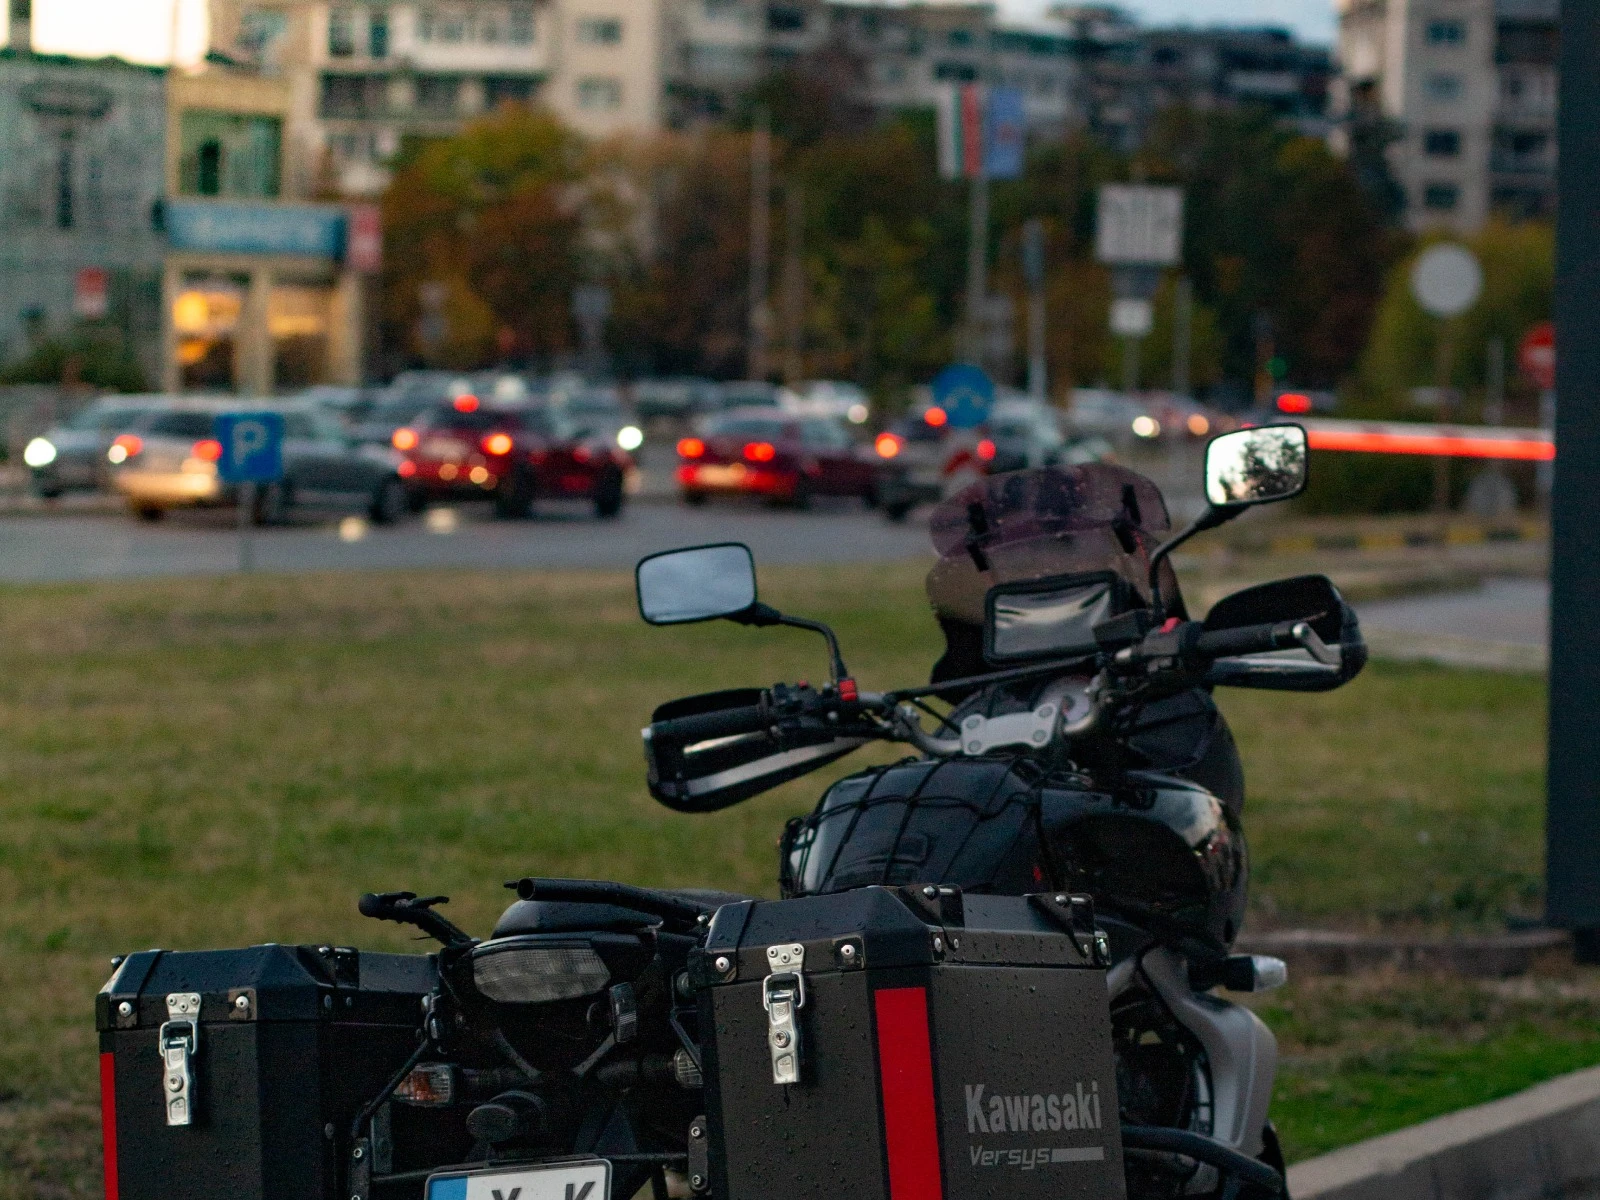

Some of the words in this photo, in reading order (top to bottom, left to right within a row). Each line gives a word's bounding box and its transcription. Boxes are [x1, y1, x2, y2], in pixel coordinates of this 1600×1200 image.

[232, 421, 267, 466] P
[964, 1080, 1102, 1134] Kawasaki
[969, 1145, 1051, 1171] Versys
